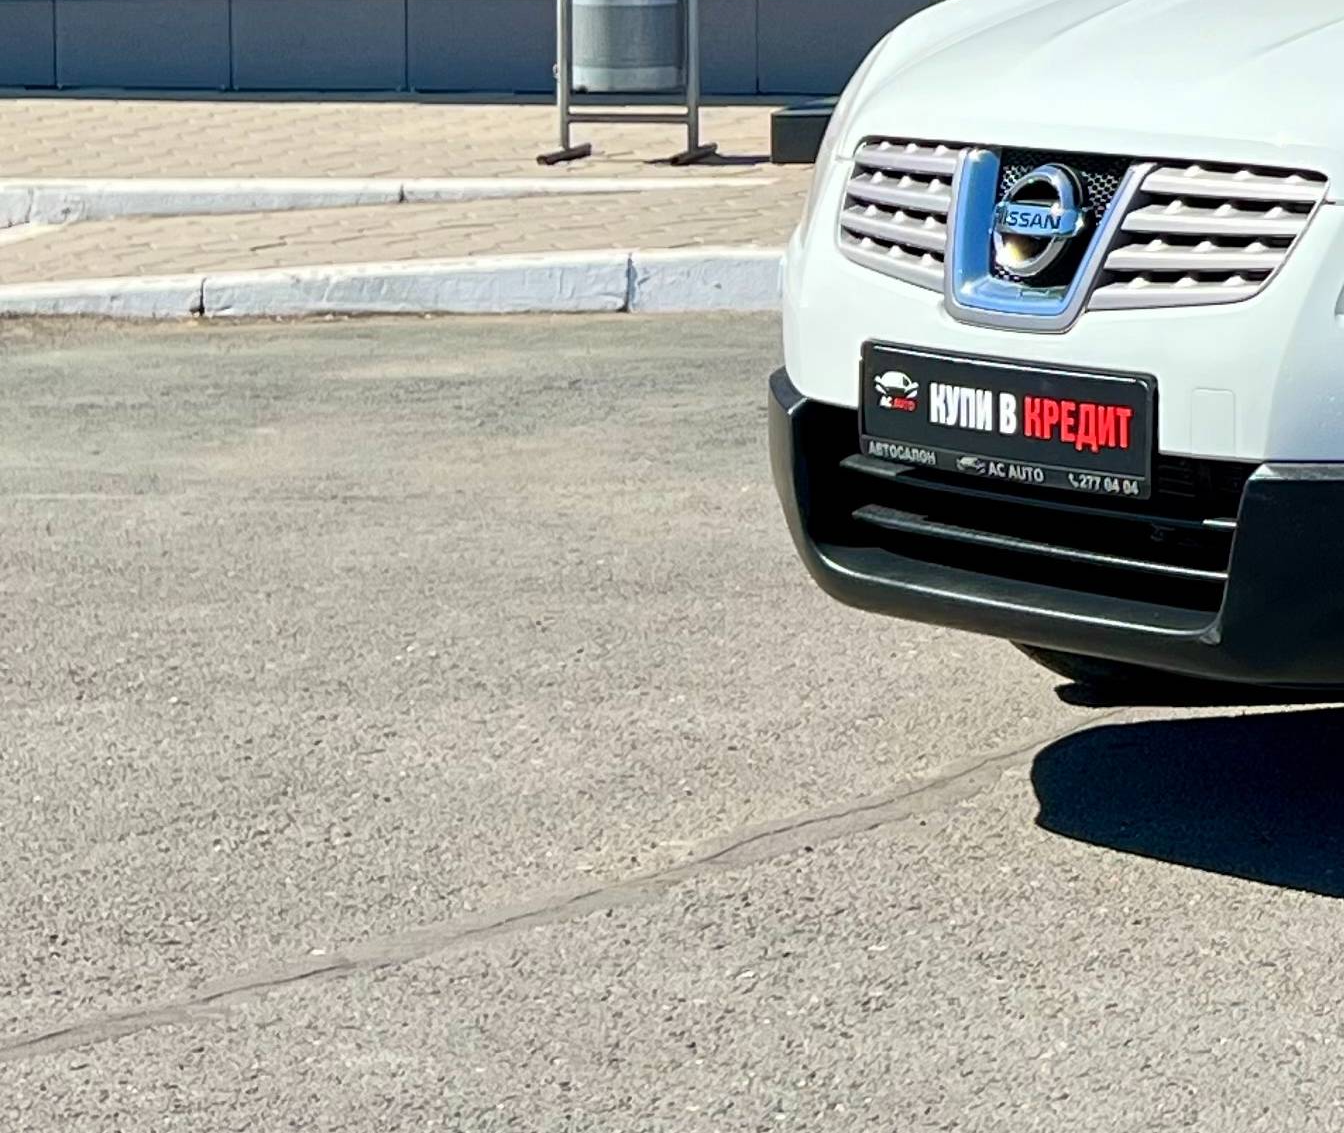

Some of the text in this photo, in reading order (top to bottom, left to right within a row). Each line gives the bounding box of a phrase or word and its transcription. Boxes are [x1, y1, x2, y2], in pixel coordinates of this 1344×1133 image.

[929, 381, 1133, 453] КУПИ В КРЕДИТ
[868, 440, 936, 466] АВТОСАЛОН
[987, 461, 1045, 483] AC AUTO
[1079, 473, 1101, 492] 277
